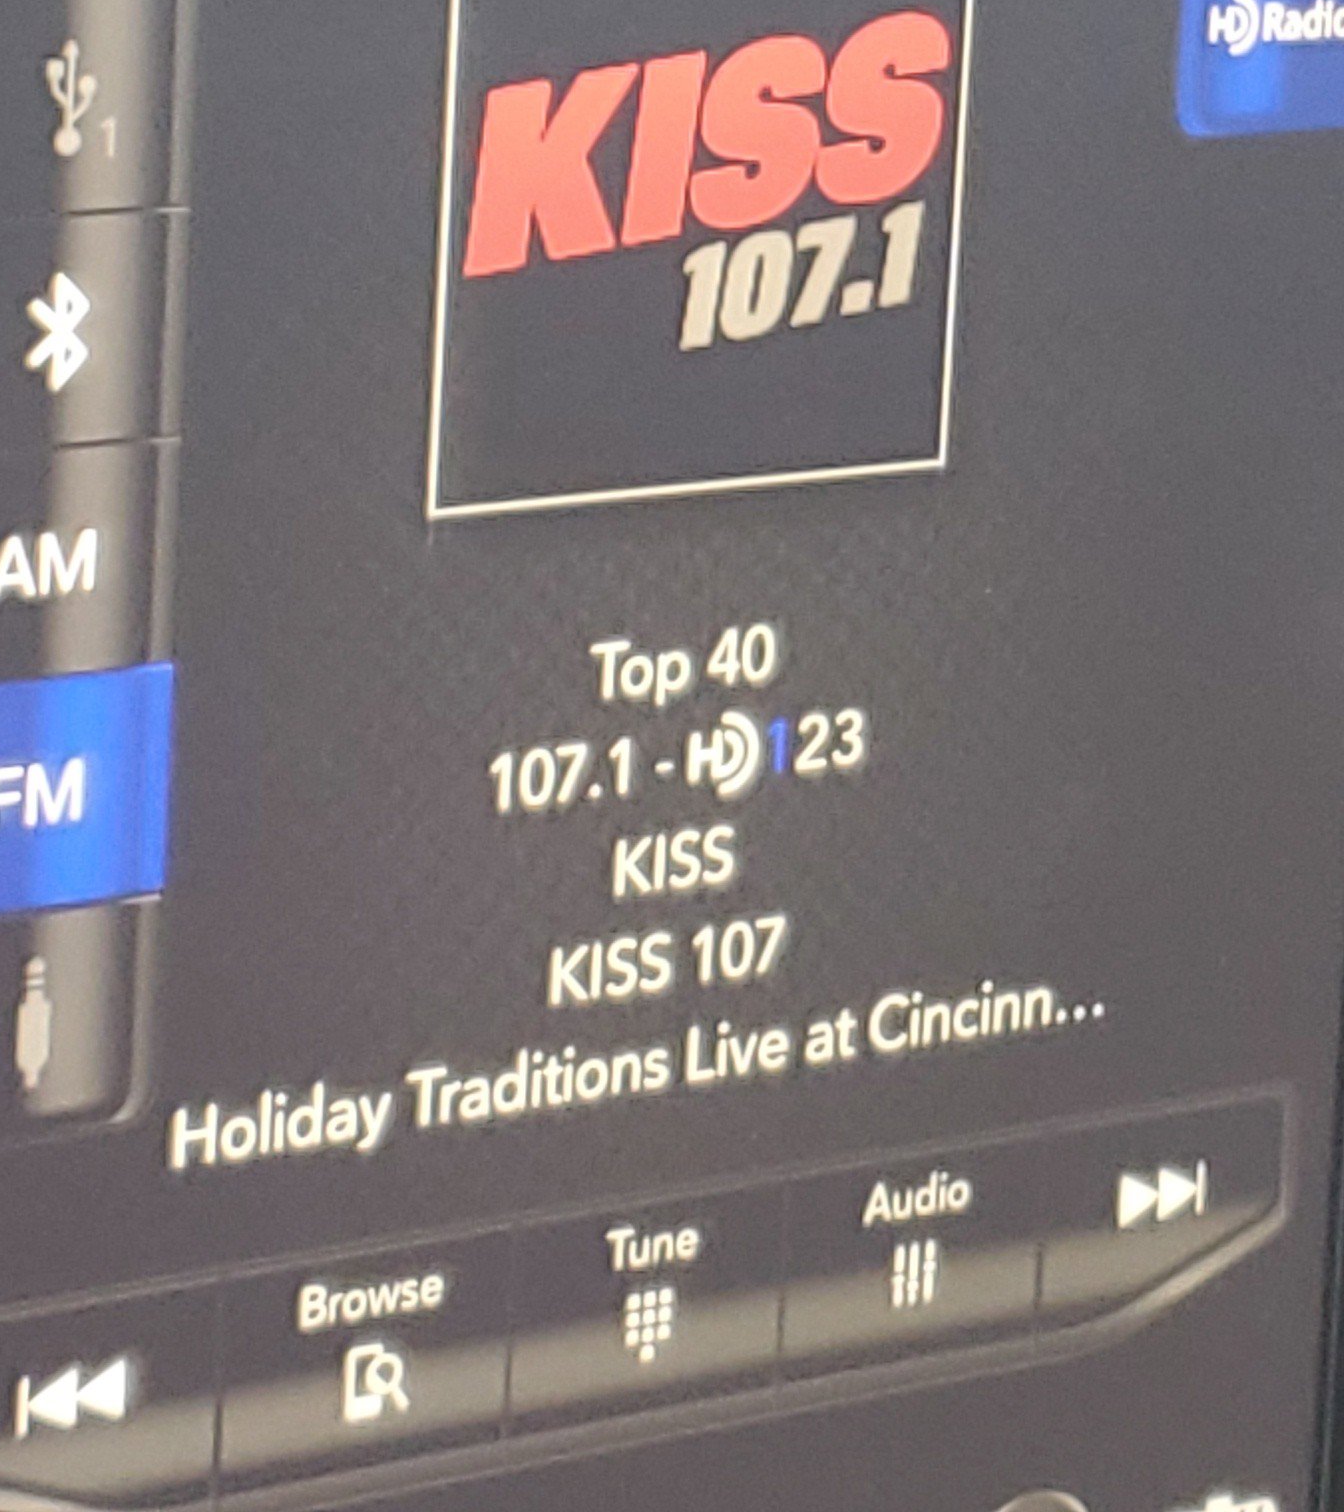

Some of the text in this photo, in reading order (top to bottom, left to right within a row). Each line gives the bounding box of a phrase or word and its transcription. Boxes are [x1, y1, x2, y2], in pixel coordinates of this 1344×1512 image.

[100, 117, 118, 159] 1
[462, 10, 951, 279] KISS
[679, 201, 926, 352] 107.1
[590, 624, 776, 705] Top 40
[489, 738, 633, 812] 107.1
[612, 826, 736, 898] KISS
[548, 916, 787, 1006] KISS 107
[170, 980, 1106, 1169] Holiday Traditions Live at Cincinn...
[863, 1173, 972, 1228] Audio
[606, 1225, 702, 1272] Tune
[298, 1271, 445, 1331] Browse
